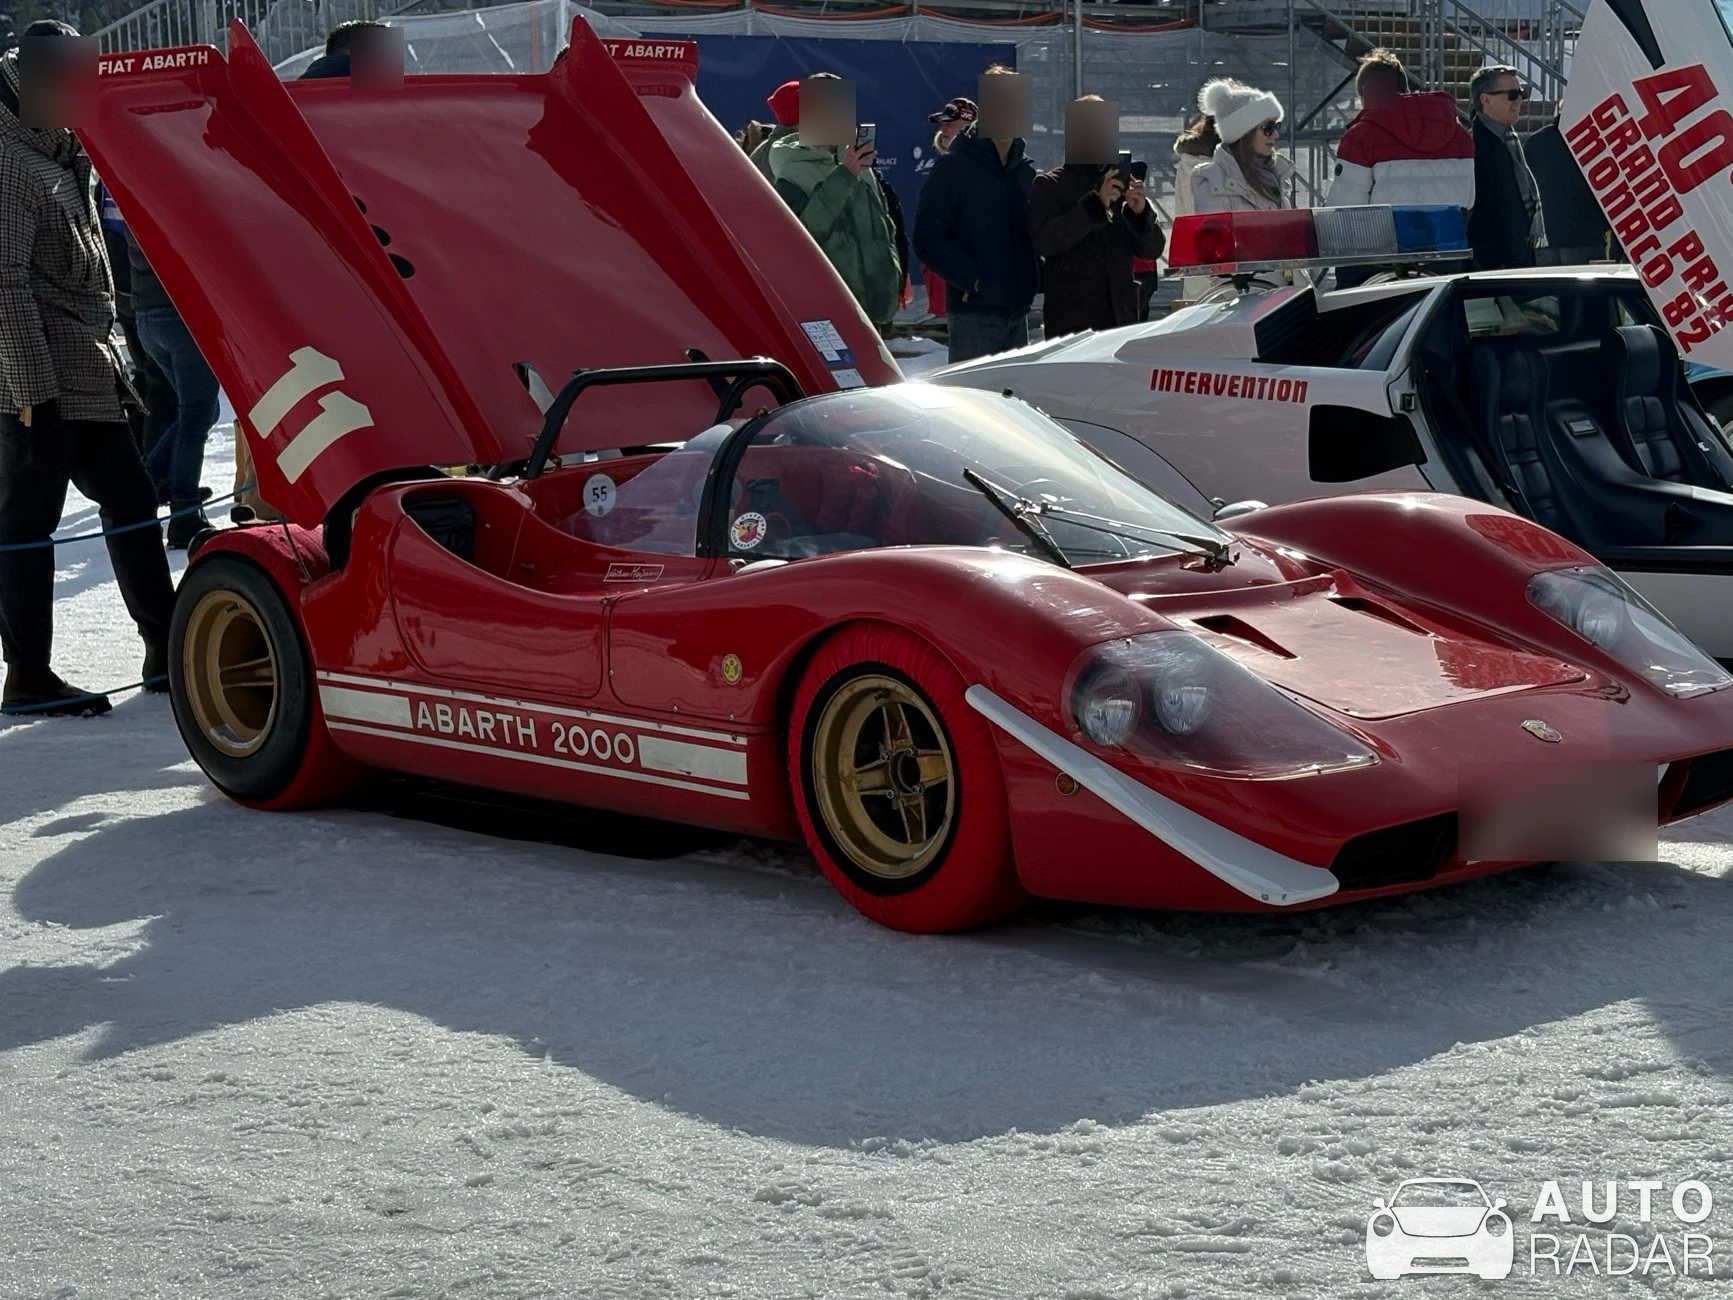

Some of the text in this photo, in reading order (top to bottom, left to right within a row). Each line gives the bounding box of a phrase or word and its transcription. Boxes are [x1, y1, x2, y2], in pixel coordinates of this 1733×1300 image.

[99, 51, 208, 75] FIAT ABARTH
[624, 45, 685, 59] ABARTH
[1592, 93, 1684, 231] GRAND
[1565, 115, 1712, 353] MONACO 82
[1150, 369, 1309, 404] INTERVENTION
[248, 346, 375, 485] 11
[592, 486, 607, 503] 55
[417, 700, 636, 765] ABARTH 2000
